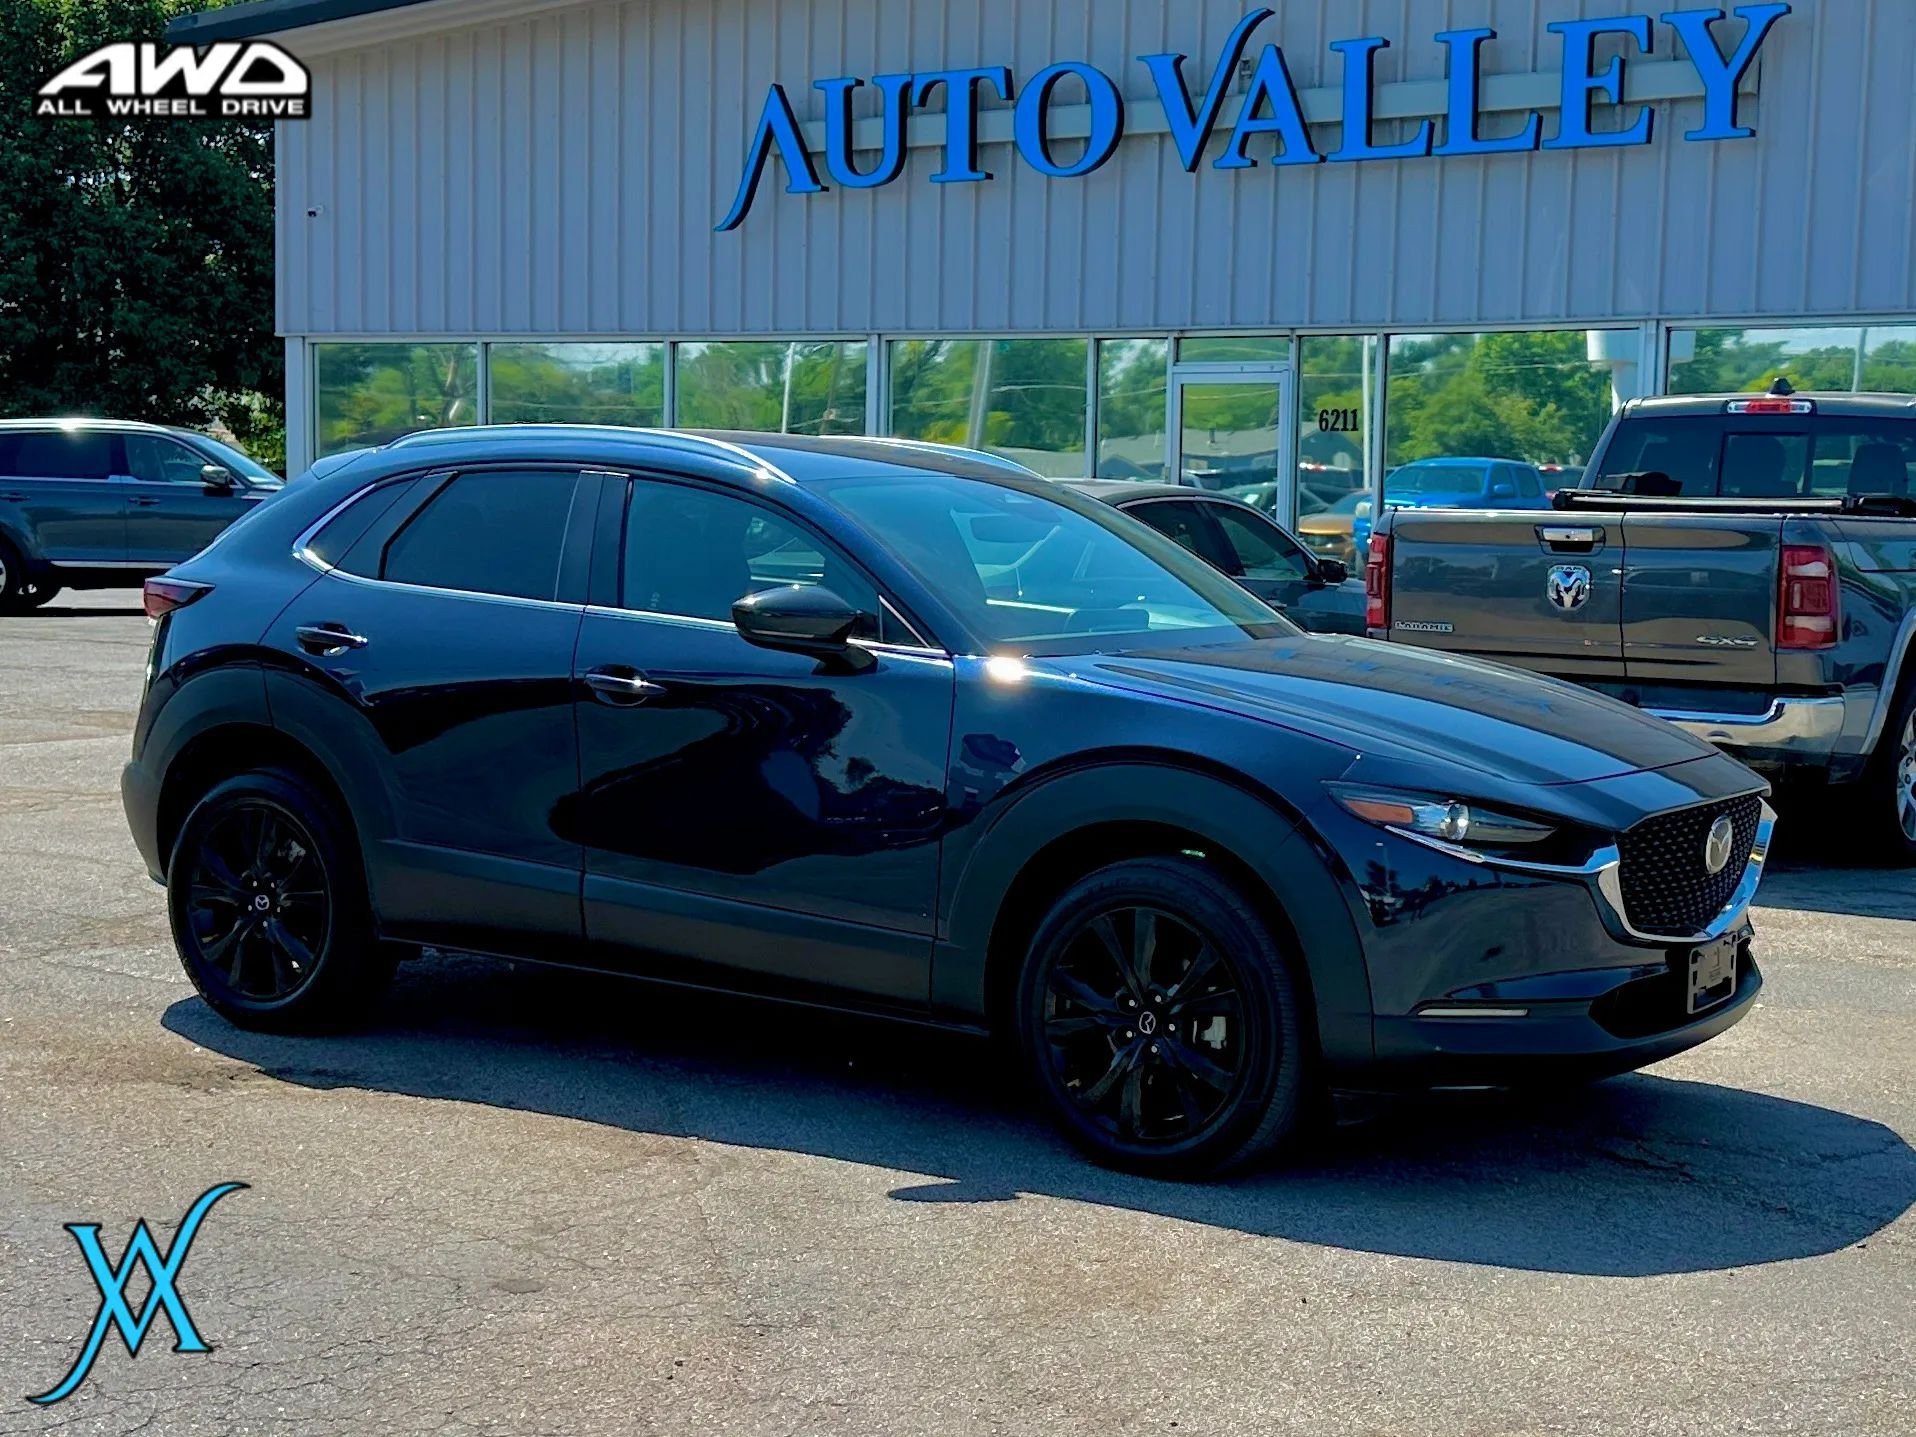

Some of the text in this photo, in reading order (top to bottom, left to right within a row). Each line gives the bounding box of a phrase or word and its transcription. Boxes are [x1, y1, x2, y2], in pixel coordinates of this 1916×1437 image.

[713, 2, 1792, 232] AUTO VALLEY
[1318, 408, 1359, 432] 6211
